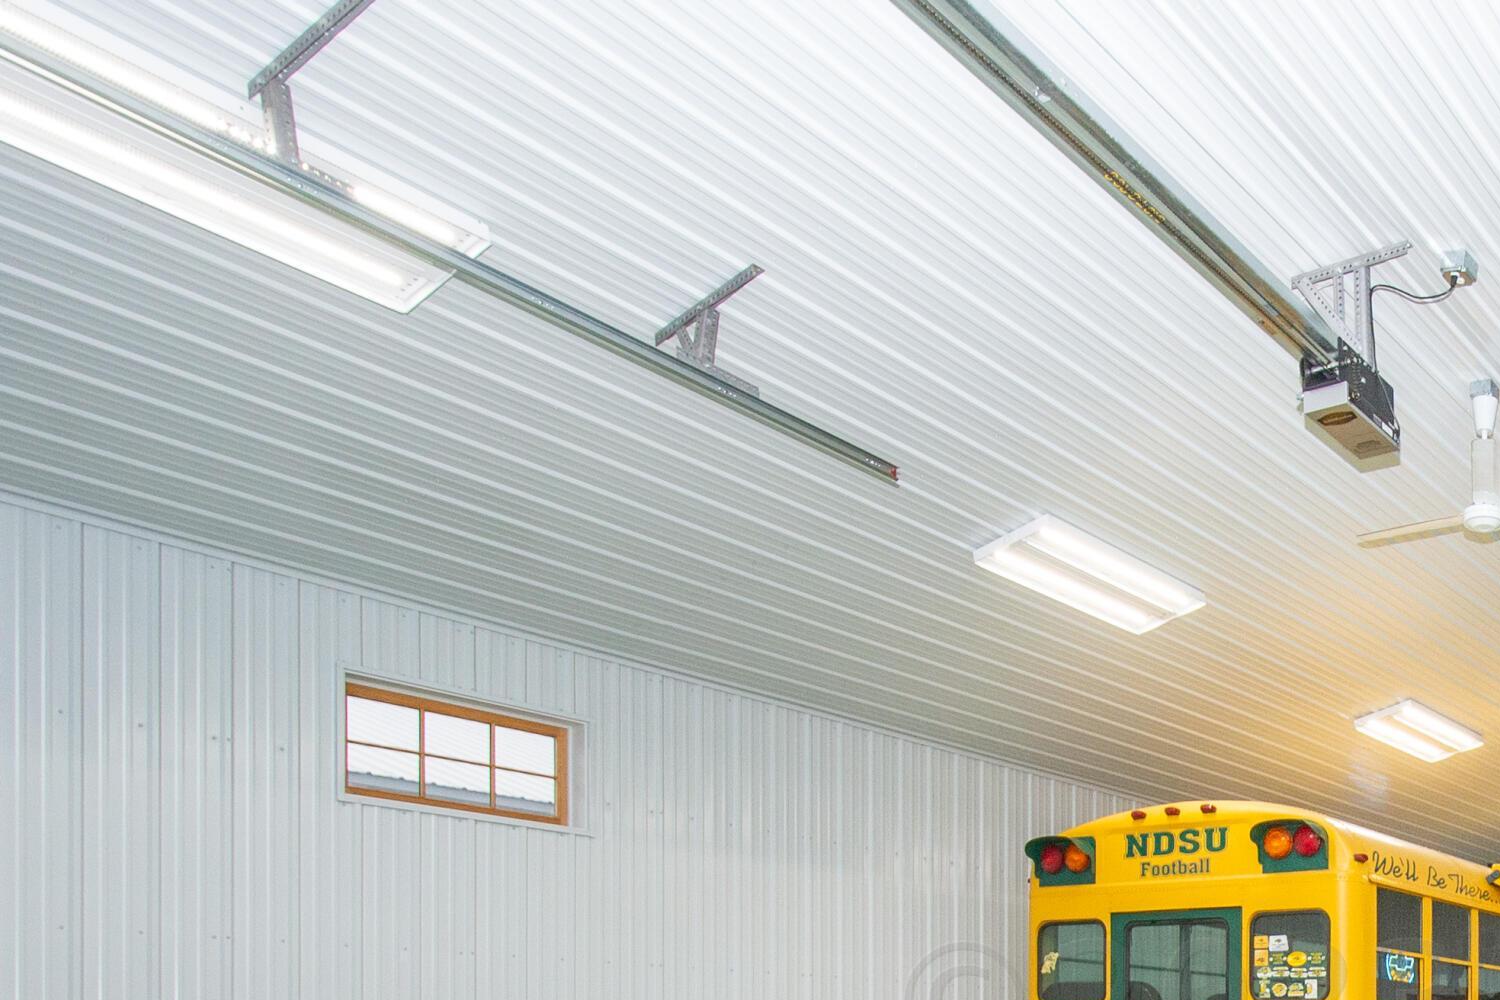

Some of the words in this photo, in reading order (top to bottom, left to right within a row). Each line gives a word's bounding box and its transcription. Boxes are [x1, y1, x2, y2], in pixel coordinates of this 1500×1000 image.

[1125, 826, 1228, 858] NDSU
[1140, 857, 1210, 877] Football
[1372, 850, 1419, 882] We'll
[1427, 866, 1448, 890] Be
